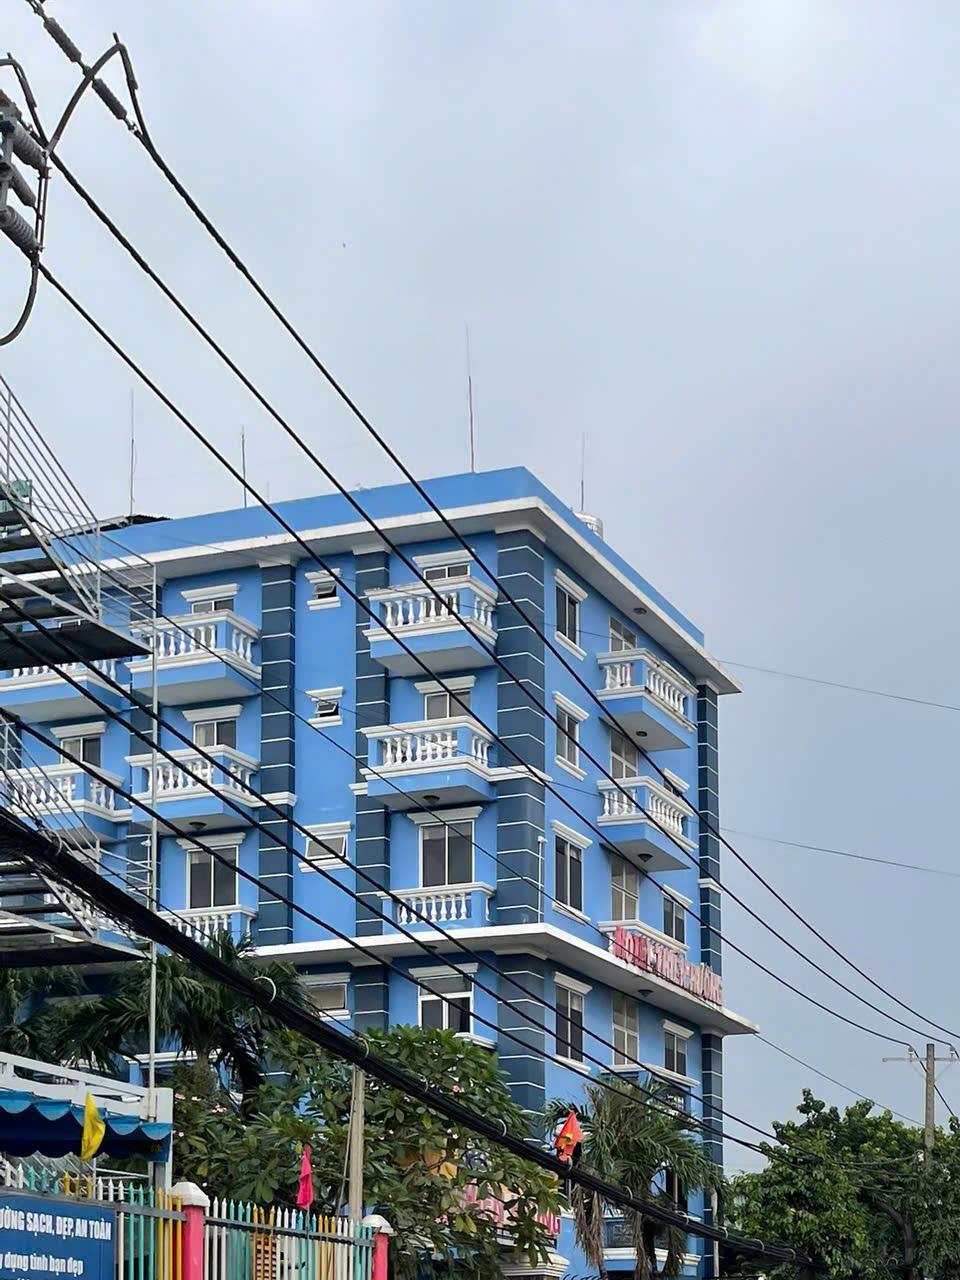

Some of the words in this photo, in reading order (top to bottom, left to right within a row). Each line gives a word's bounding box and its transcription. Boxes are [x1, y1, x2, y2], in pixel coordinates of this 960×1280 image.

[26, 1212, 55, 1236] SẠCH,
[75, 1218, 88, 1238] AN
[89, 1218, 112, 1240] TOÀN
[30, 1253, 48, 1271] tình
[49, 1255, 66, 1276] bạn
[67, 1257, 84, 1277] đẹp
